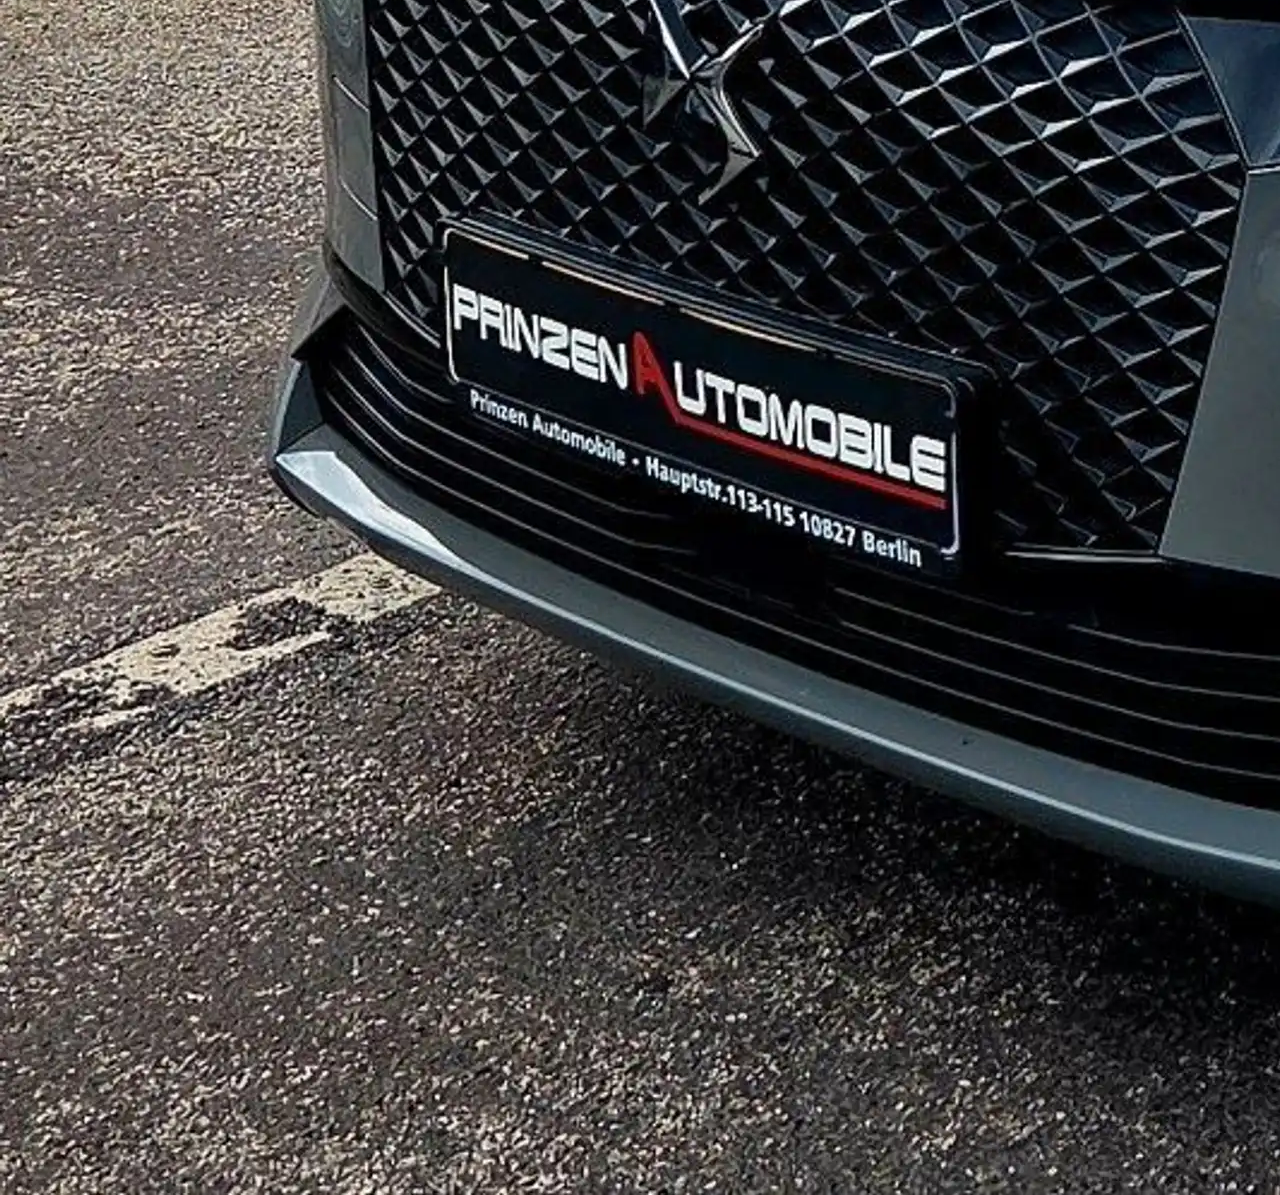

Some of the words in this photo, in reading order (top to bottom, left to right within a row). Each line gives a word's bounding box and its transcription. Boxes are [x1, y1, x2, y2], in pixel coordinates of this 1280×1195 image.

[453, 282, 628, 390] PRINZEN
[632, 330, 947, 492] AUTOMOBILE
[470, 389, 529, 428] Prinzen
[532, 412, 626, 465] Automobile
[799, 511, 857, 548] 10827
[862, 531, 923, 567] Berlin
